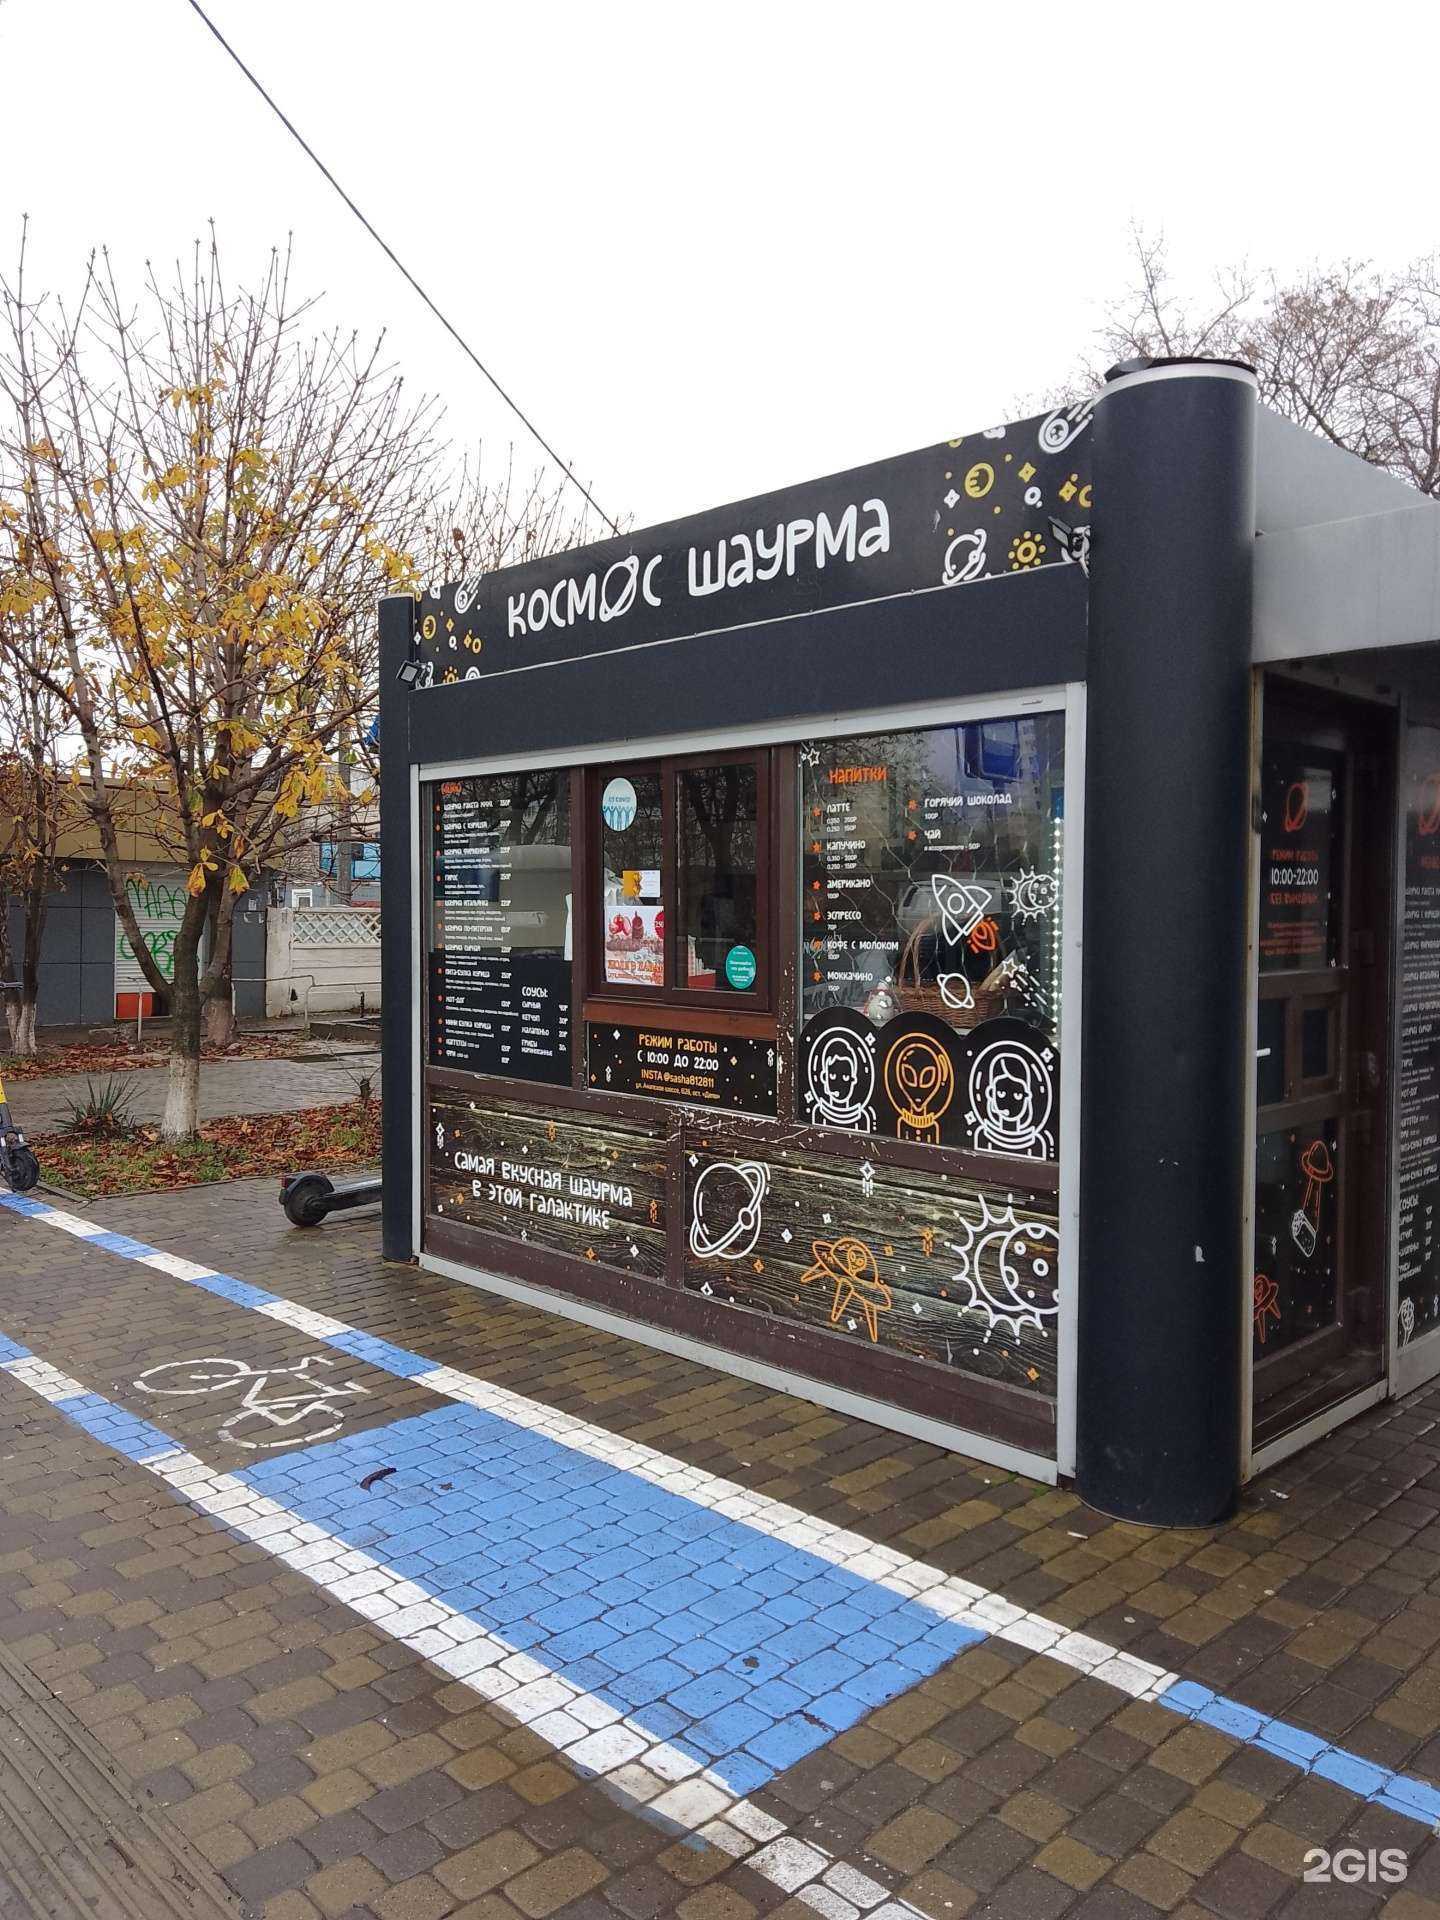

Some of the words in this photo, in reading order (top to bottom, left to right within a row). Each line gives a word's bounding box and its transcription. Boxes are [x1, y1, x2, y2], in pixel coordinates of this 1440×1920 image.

[508, 555, 662, 638] КОСМОС
[688, 498, 890, 596] ШАУРМА
[829, 768, 887, 784] НАПИТКИ
[827, 803, 850, 813] ЛАТТЕ
[924, 796, 963, 808] ГОРЯЧИЙ
[967, 793, 1012, 806] ШОКОЛАД
[924, 829, 941, 840] ЧАЙ
[827, 840, 866, 850] КАПУЧИНО
[827, 879, 871, 889] АМЕРИКАНО
[1271, 867, 1319, 886] 10:00-22:00
[827, 911, 861, 920] ЭСПРЕССО
[827, 941, 848, 950] КОФЕ
[851, 940, 856, 949] С
[860, 941, 899, 950] МОЛОКОМ
[827, 971, 873, 981] МОККАЧИНО
[639, 1034, 673, 1049] РЕЖИМ
[677, 1039, 718, 1053] РАБОТЫ
[637, 1050, 643, 1063] С
[647, 1051, 669, 1065] 10:00
[673, 1054, 689, 1068] ДО
[694, 1057, 718, 1071] 22:00
[454, 1152, 495, 1176] САМАЯ
[502, 1161, 562, 1190] ВКУСНАЯ
[570, 1175, 633, 1207] ШАУРМА
[472, 1180, 482, 1197] В
[489, 1184, 522, 1209] ЭТОЙ
[530, 1193, 610, 1230] ГАЛАКТИКЕ
